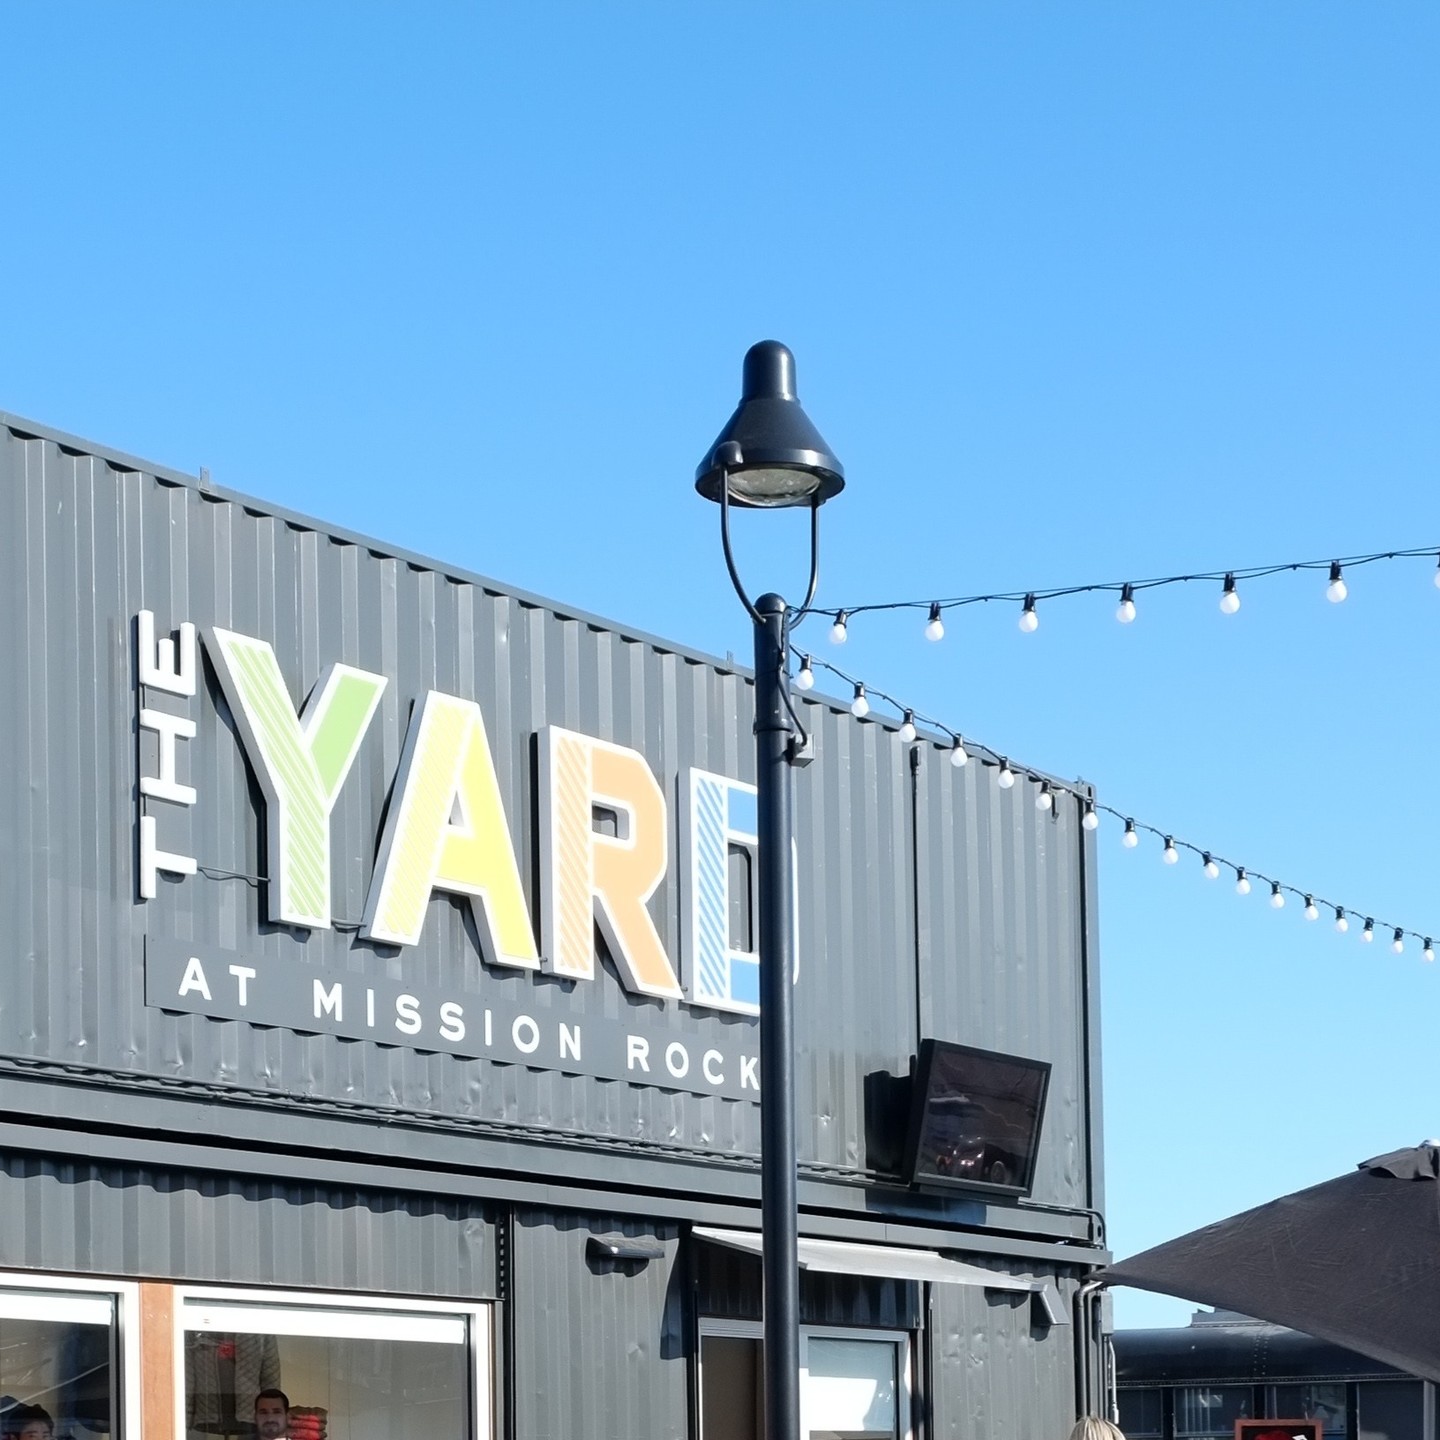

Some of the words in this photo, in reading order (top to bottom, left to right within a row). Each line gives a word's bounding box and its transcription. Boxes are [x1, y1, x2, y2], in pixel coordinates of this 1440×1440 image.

[138, 610, 197, 901] THE
[202, 626, 798, 1017] YARD
[178, 957, 256, 1006] AT
[313, 982, 582, 1063] MISSION
[627, 1035, 760, 1091] ROCK
